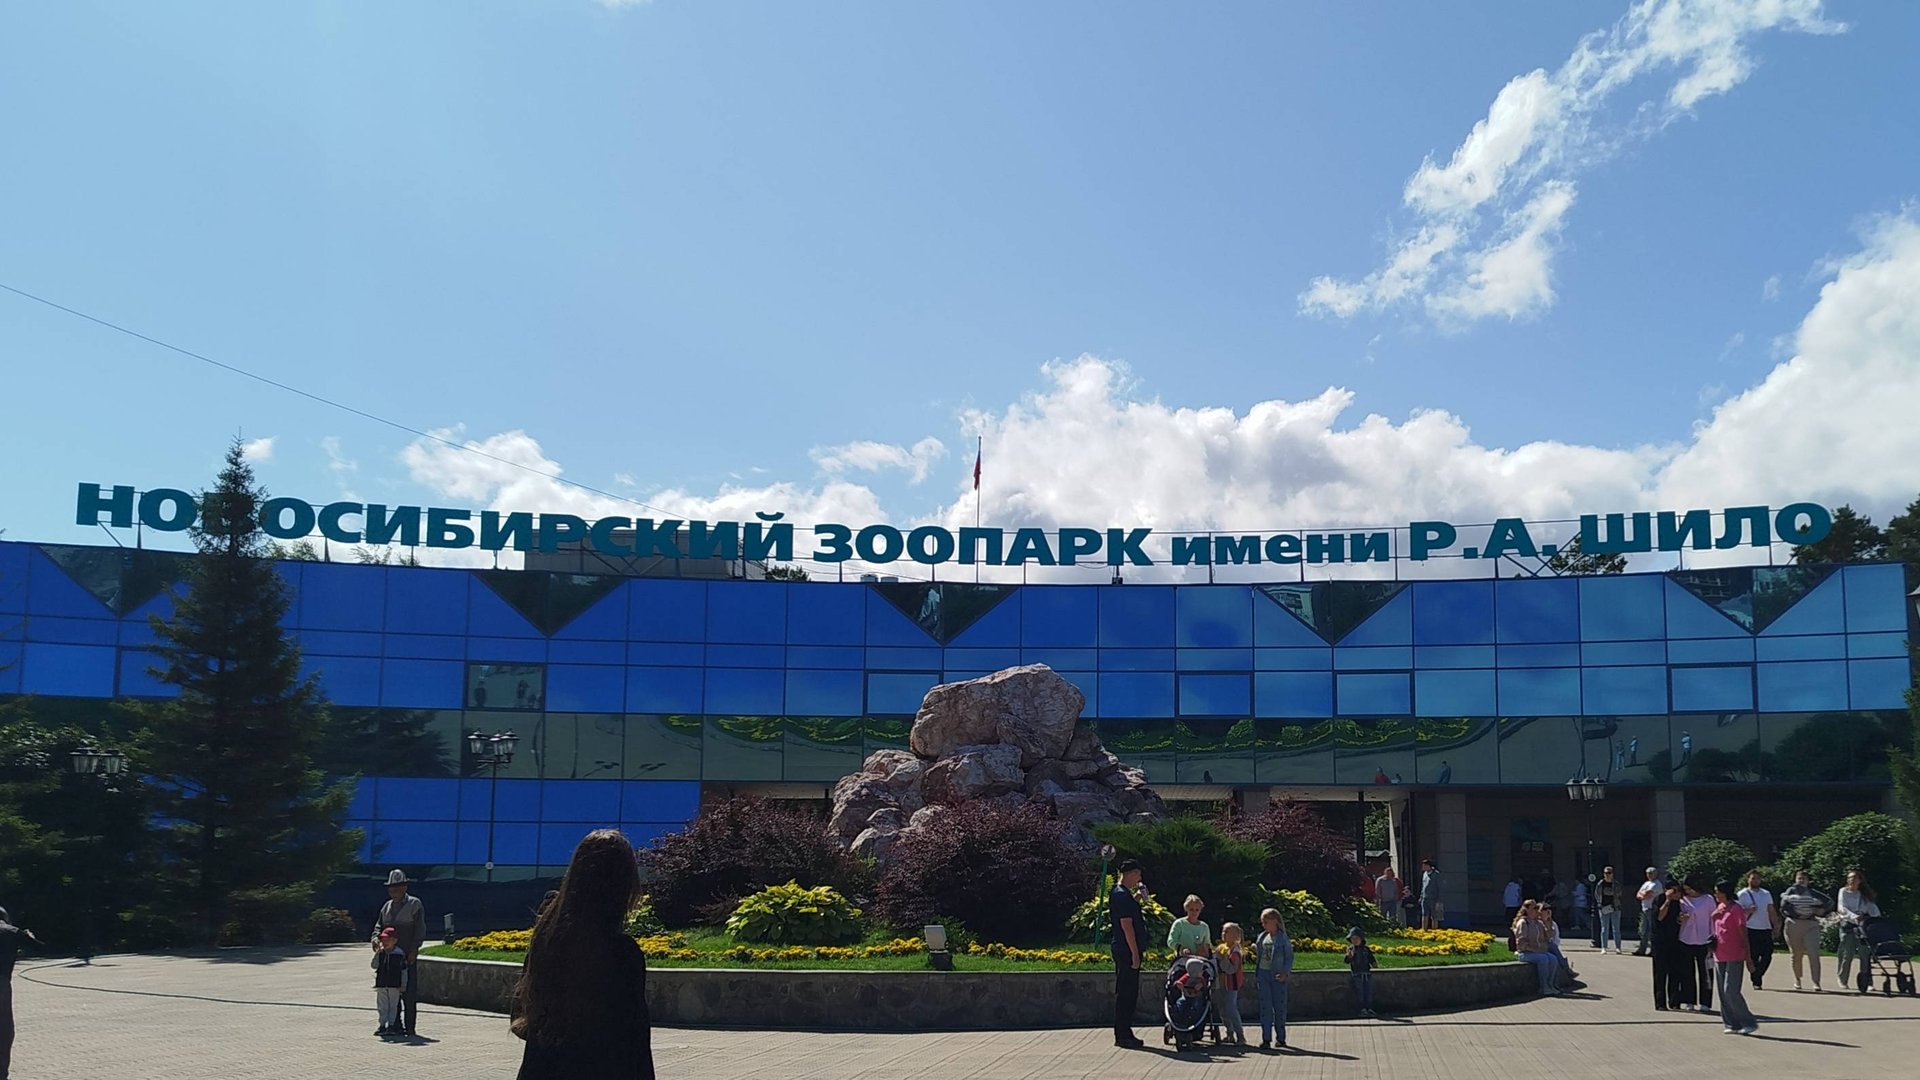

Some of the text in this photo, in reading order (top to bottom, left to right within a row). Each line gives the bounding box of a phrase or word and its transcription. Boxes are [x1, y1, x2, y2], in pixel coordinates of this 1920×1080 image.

[813, 523, 1153, 567] ЗООПАРК
[1171, 532, 1390, 566] имени
[1409, 516, 1558, 562] Р.А.
[1579, 502, 1833, 556] ШИЛО
